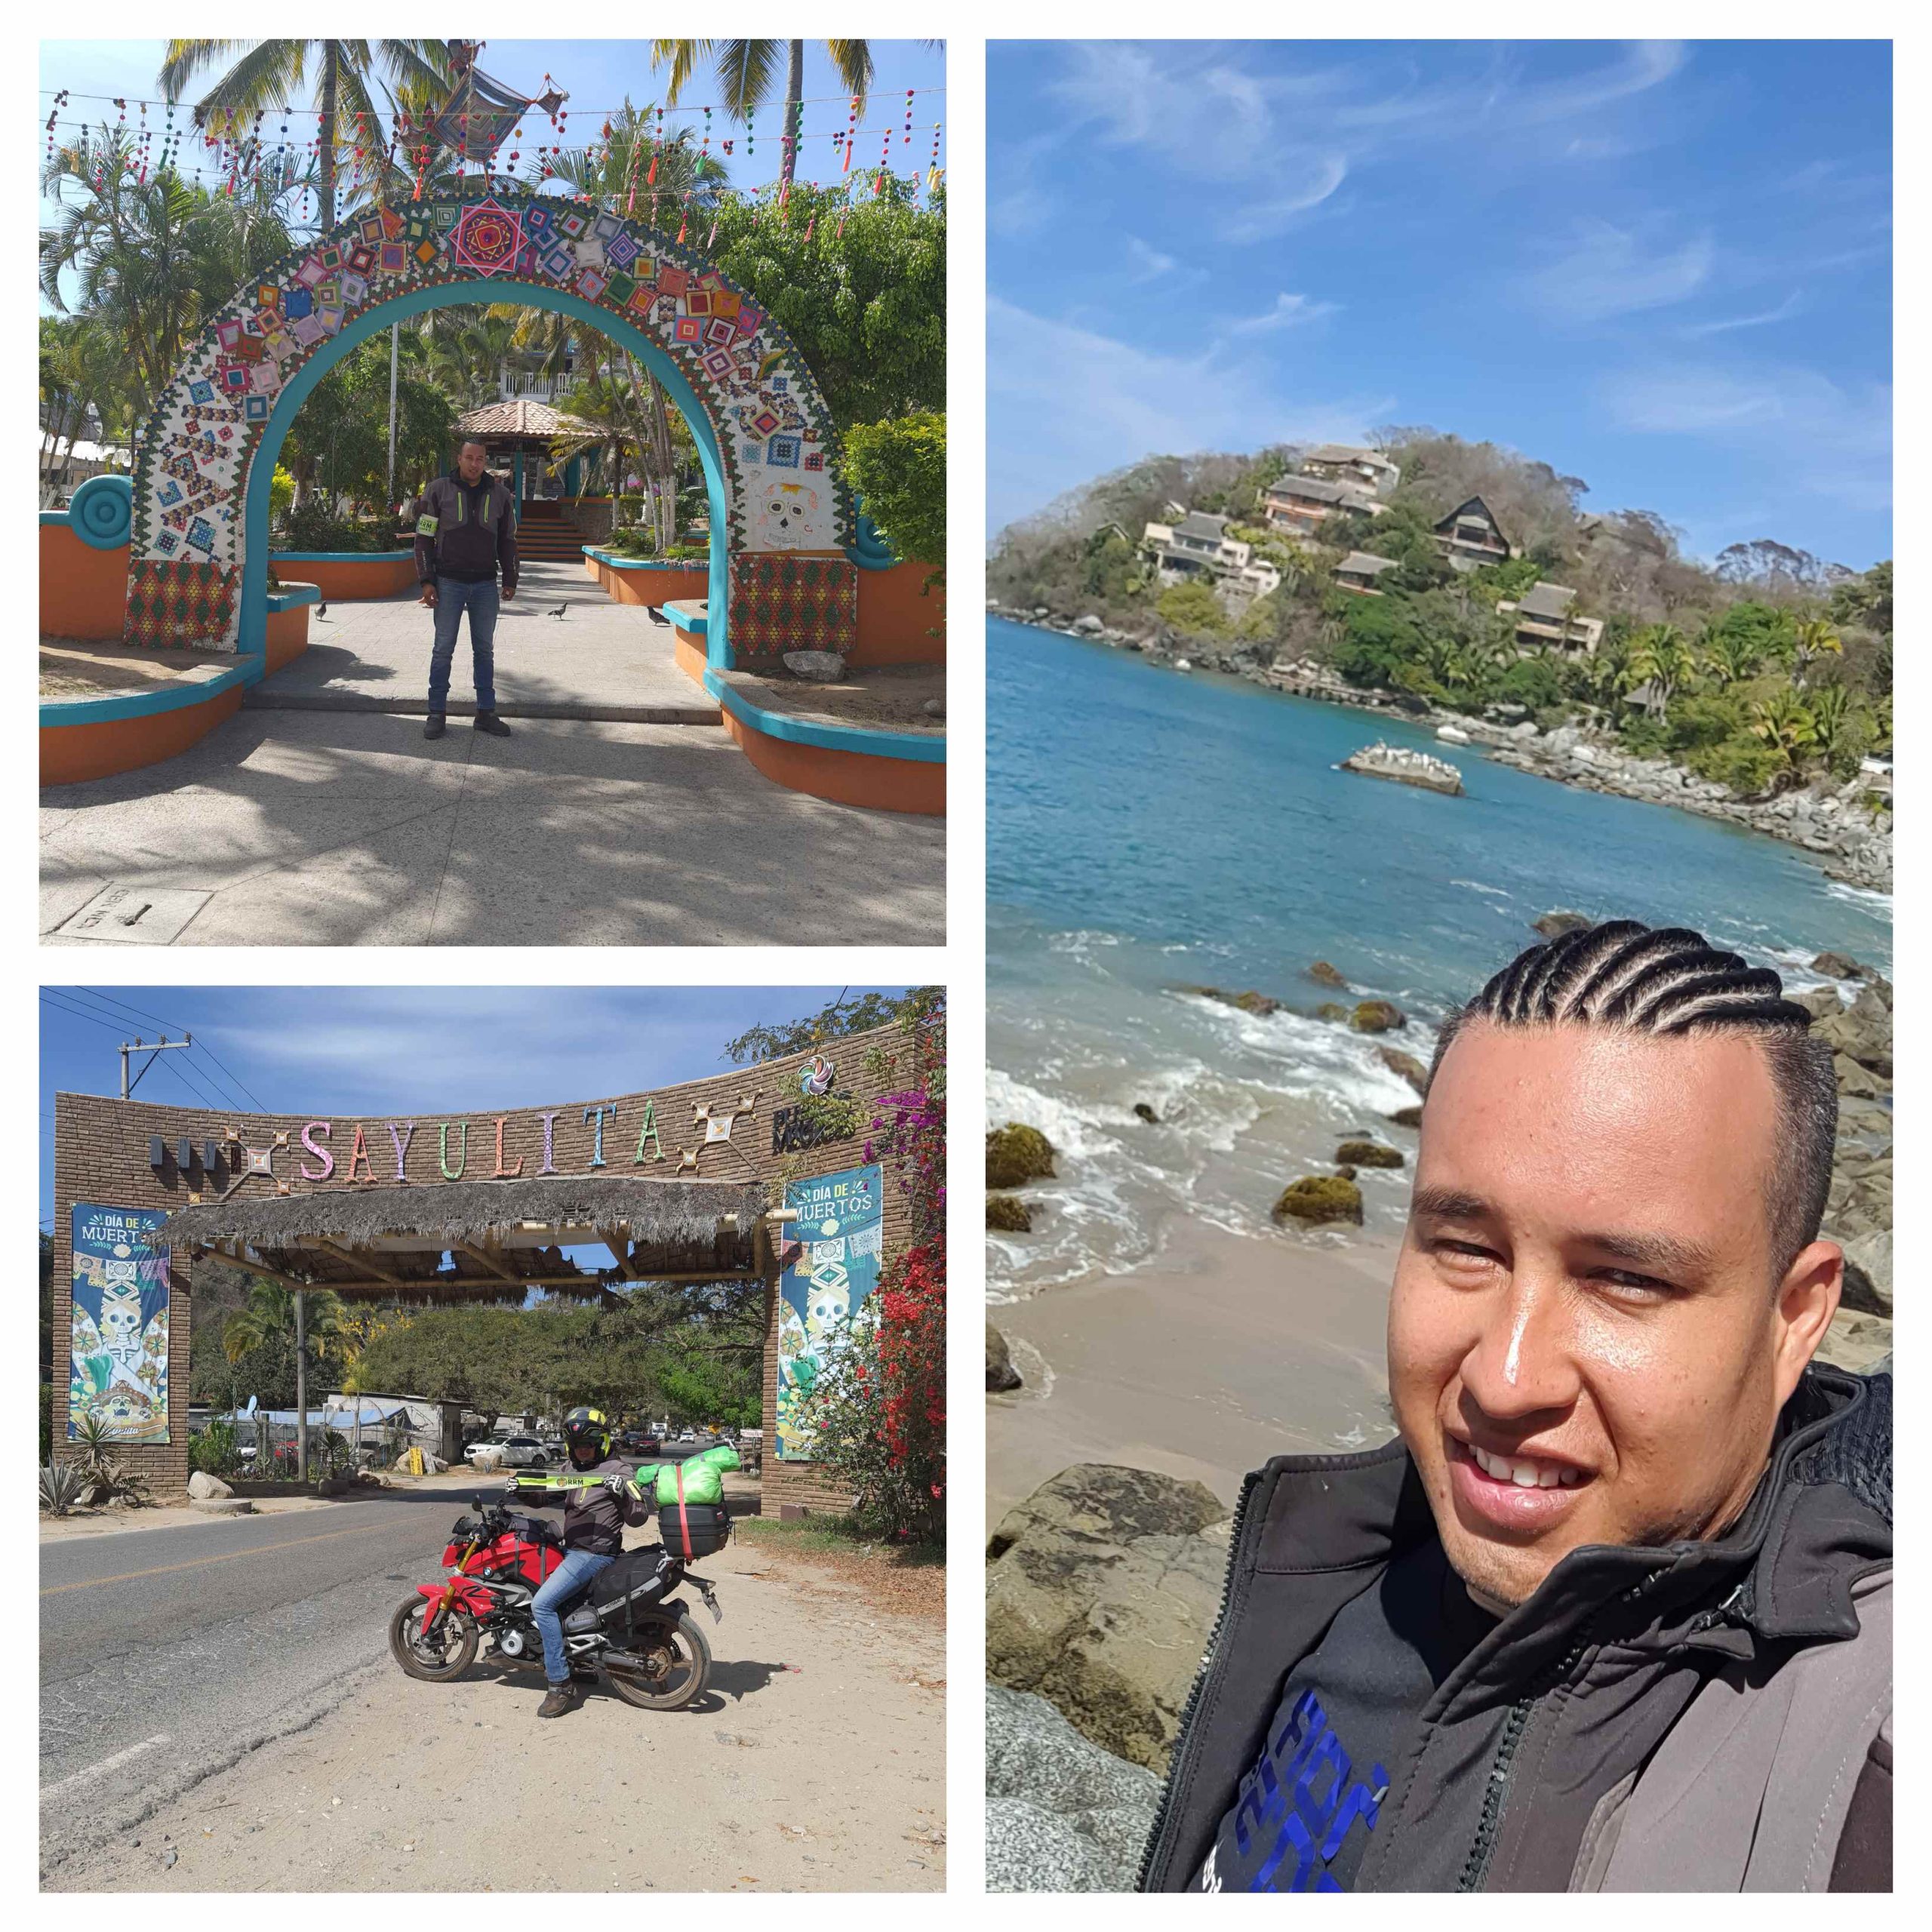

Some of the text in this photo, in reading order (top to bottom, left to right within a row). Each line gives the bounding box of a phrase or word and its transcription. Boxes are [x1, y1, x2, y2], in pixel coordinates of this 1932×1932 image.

[300, 1099, 666, 1183] SAYULITA
[813, 1183, 849, 1201] DÍA DE
[105, 1214, 140, 1229] DÍA DE
[82, 1226, 145, 1244] MUERT
